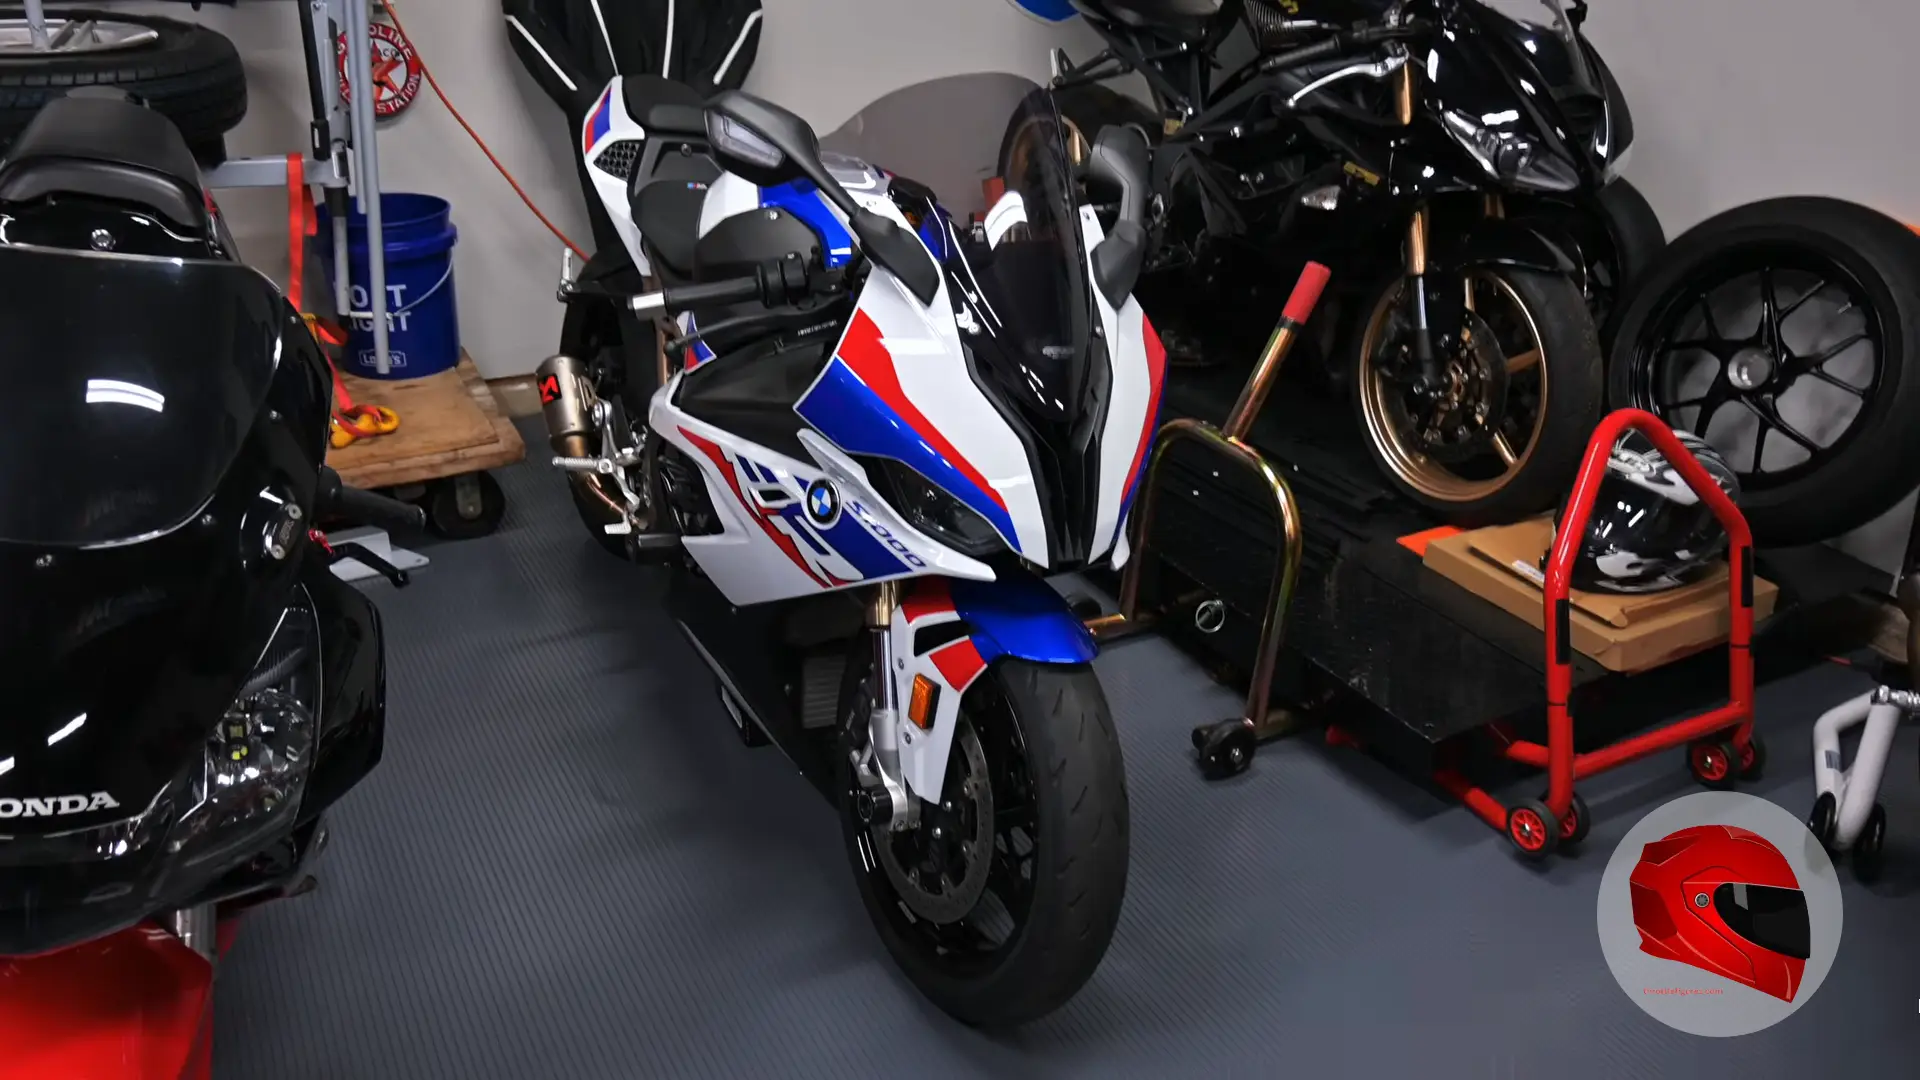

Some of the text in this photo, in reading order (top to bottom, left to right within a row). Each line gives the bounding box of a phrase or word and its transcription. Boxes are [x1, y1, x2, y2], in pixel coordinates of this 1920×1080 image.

[337, 24, 413, 60] GOLINE
[377, 74, 420, 113] STATION
[348, 311, 411, 332] IGT
[363, 353, 401, 365] Lo's
